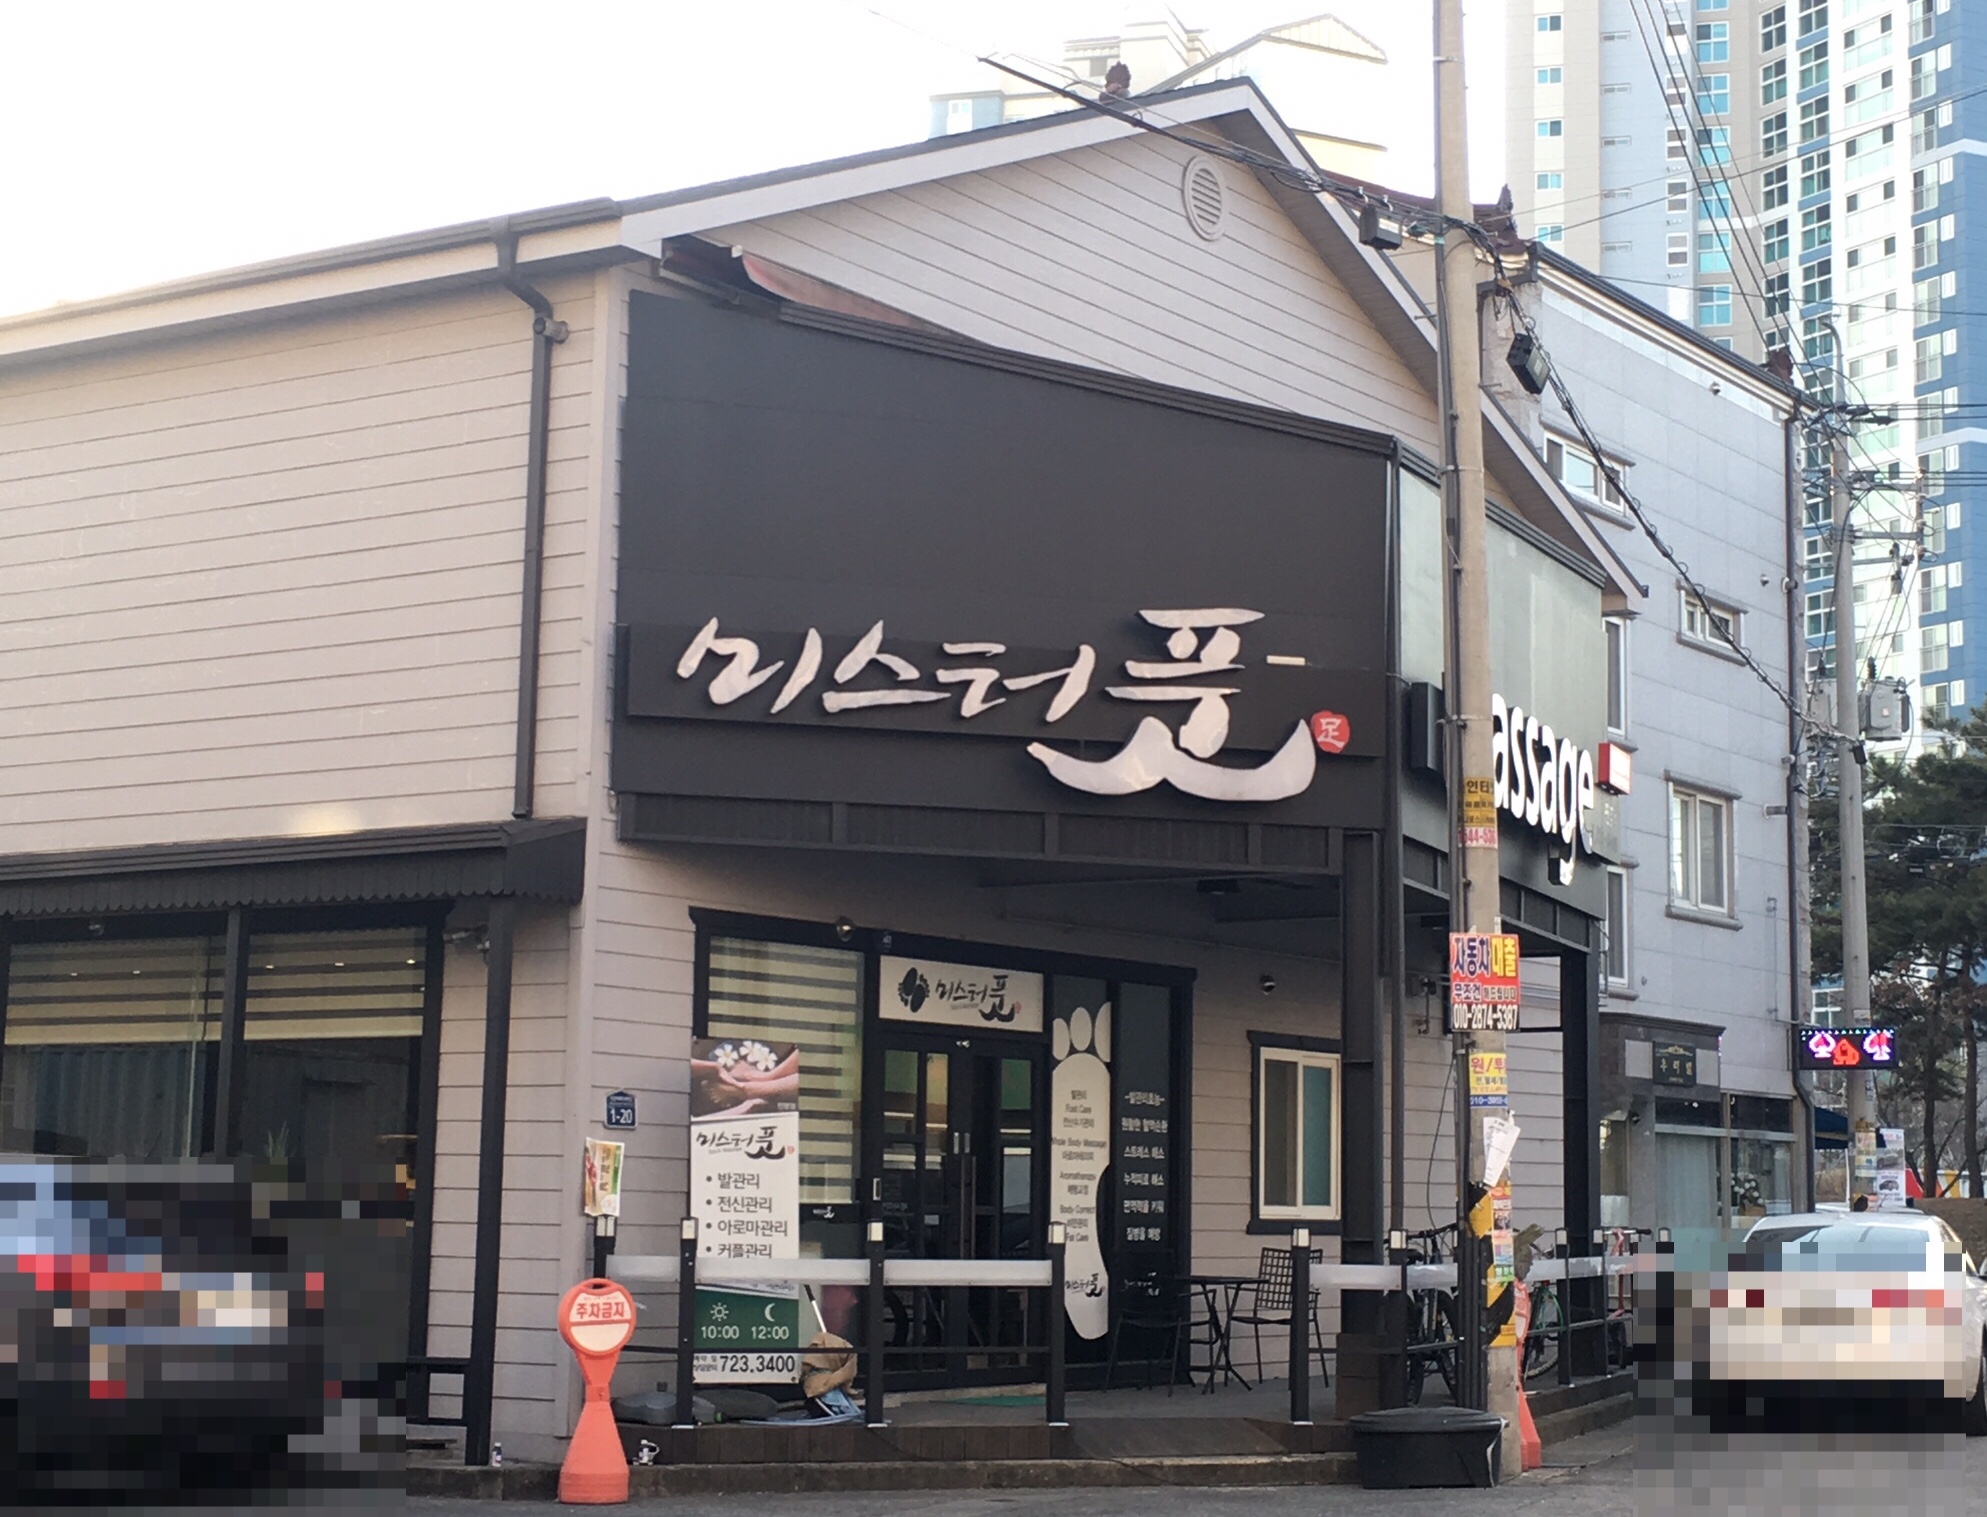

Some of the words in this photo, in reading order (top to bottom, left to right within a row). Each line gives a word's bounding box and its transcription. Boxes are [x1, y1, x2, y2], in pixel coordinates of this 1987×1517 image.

[1492, 692, 1594, 886] assage
[1454, 983, 1481, 1001] 무조건
[1453, 1003, 1518, 1030] 010-2874-5387
[610, 1108, 634, 1124] 1-20
[717, 1173, 760, 1189] 발관리
[717, 1196, 773, 1213] 전신관리
[717, 1220, 788, 1237] 아로마관리
[717, 1243, 773, 1258] 커플관리
[576, 1301, 625, 1319] 주차금지
[701, 1325, 740, 1339] 10:00
[751, 1325, 790, 1340] 12:00
[720, 1354, 796, 1374] 723.3400
